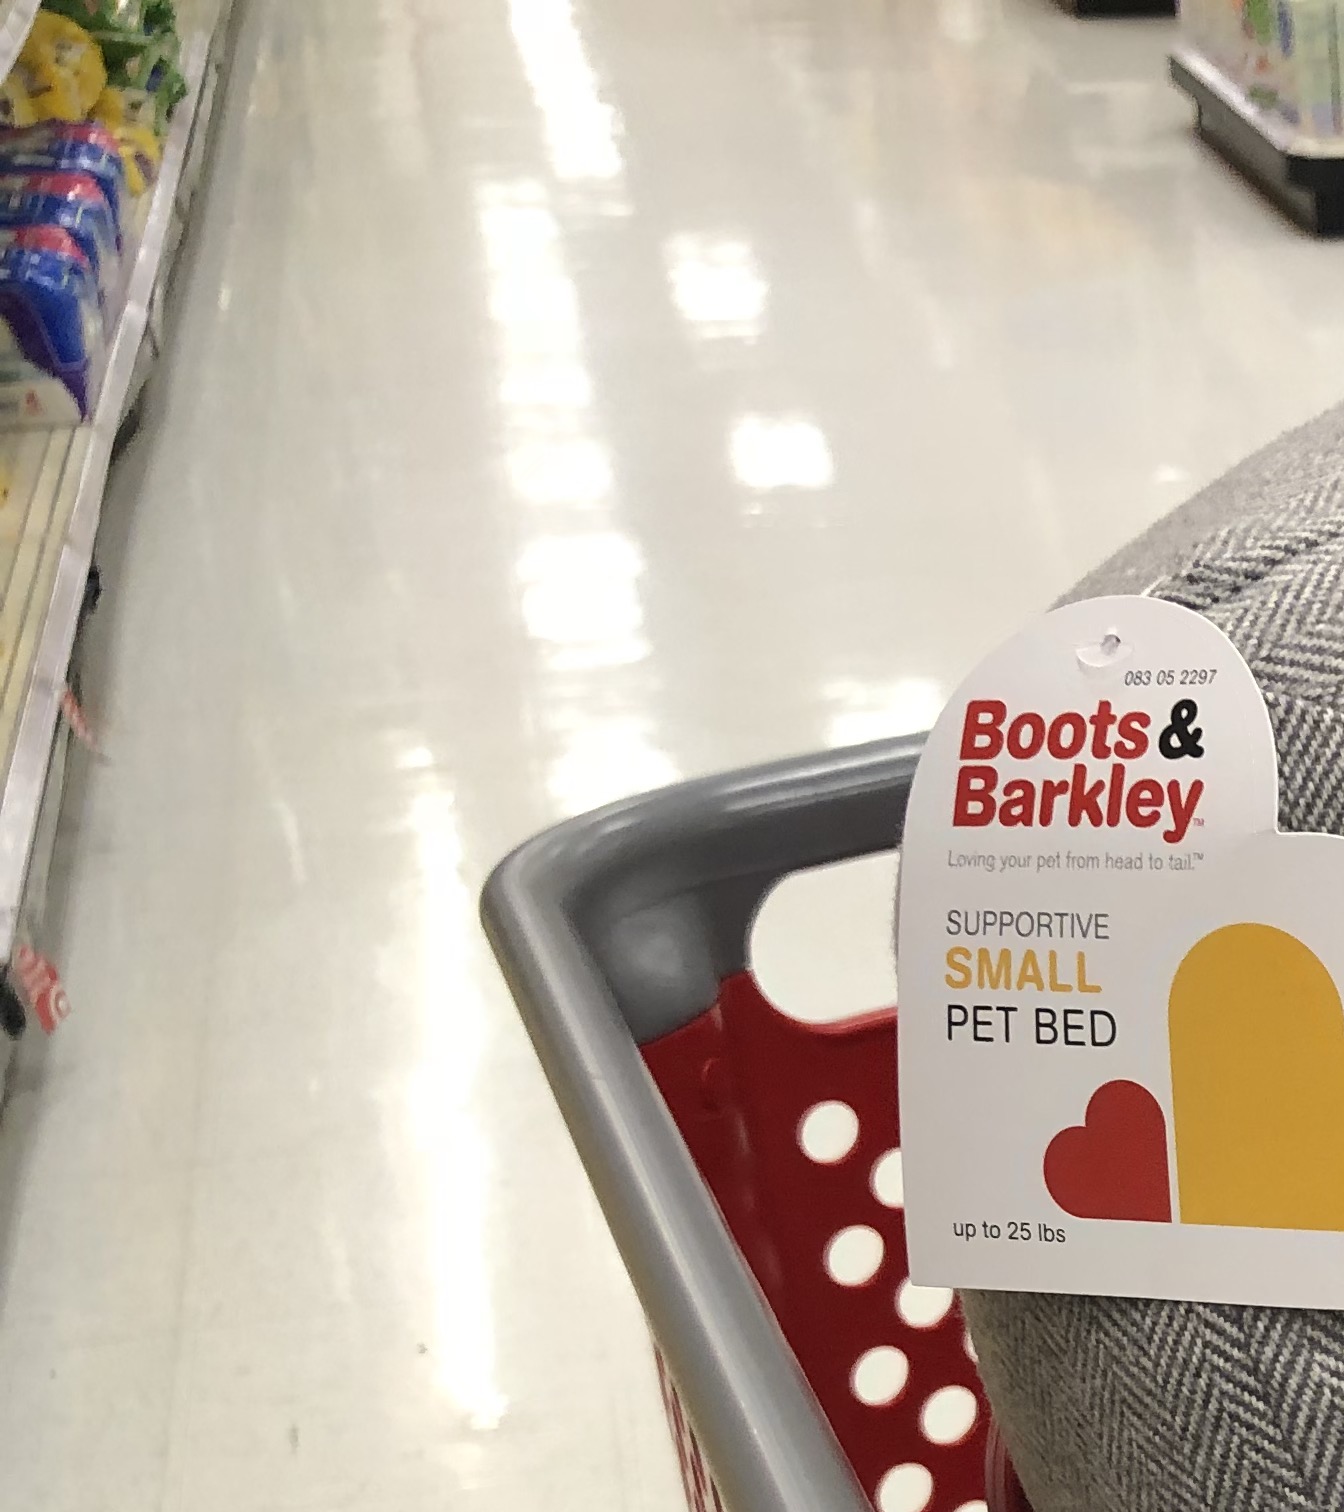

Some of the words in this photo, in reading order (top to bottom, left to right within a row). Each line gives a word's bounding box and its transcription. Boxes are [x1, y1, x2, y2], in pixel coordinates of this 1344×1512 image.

[1124, 670, 1152, 686] 083
[1156, 669, 1175, 686] 05
[1179, 669, 1218, 685] 2297
[947, 850, 995, 873] Loving
[999, 854, 1031, 873] your
[1037, 852, 1061, 871] pet
[1066, 851, 1100, 869] from
[1104, 852, 1144, 870] head
[1149, 853, 1163, 870] to
[946, 909, 1109, 939] SUPPORTIVE
[944, 946, 1102, 993] SMALL
[947, 1004, 1018, 1043] PET
[1035, 1007, 1117, 1047] BED
[953, 1222, 976, 1241] up
[982, 1221, 1000, 1238] to
[1007, 1221, 1031, 1241] 25
[1038, 1222, 1066, 1242] lbs
